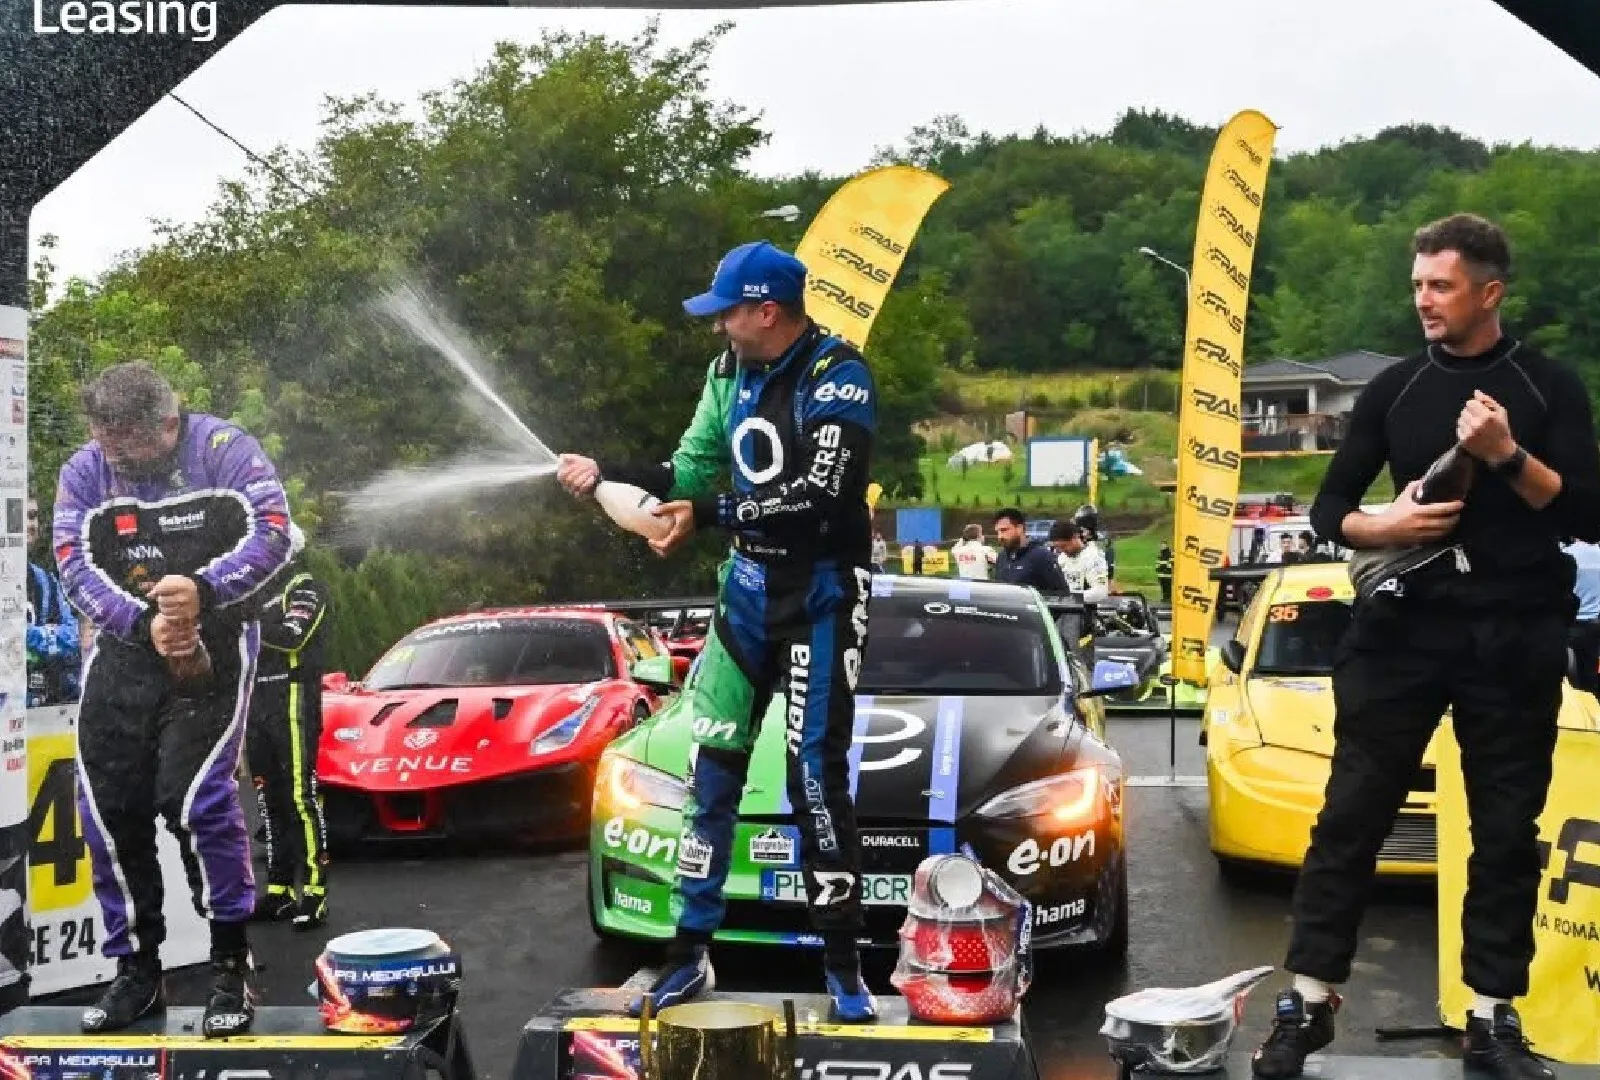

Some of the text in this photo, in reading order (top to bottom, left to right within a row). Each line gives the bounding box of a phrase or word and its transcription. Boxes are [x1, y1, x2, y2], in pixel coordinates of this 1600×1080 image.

[33, 0, 217, 42] Leasing
[1228, 168, 1261, 207] FRAS
[861, 225, 905, 255] FRAS
[1218, 204, 1255, 248] FRAS
[834, 248, 891, 284] FRAS
[1208, 246, 1248, 291] FRAS
[815, 278, 875, 319] FRAS
[349, 756, 473, 776] VENUE
[861, 834, 920, 848] DURACELL
[614, 887, 653, 914] hama
[1035, 898, 1086, 926] hama
[60, 916, 96, 961] 24
